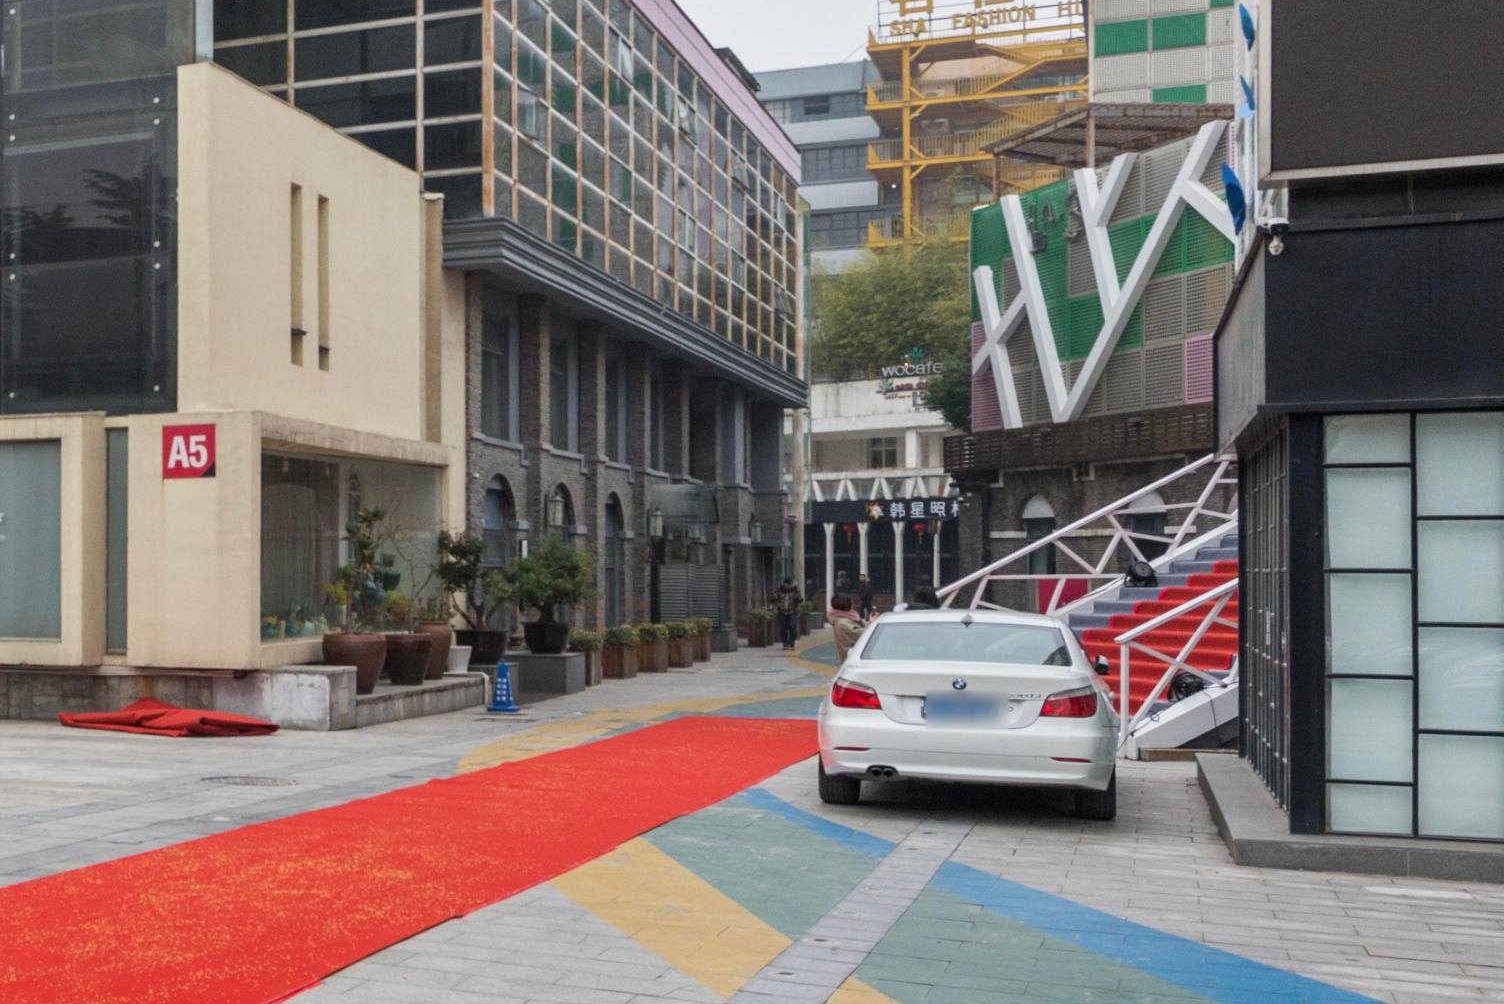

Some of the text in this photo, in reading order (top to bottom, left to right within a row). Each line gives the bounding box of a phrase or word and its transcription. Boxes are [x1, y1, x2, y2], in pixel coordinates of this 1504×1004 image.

[952, 4, 1036, 30] FASHION
[881, 360, 943, 377] wocafe
[167, 434, 209, 469] A5
